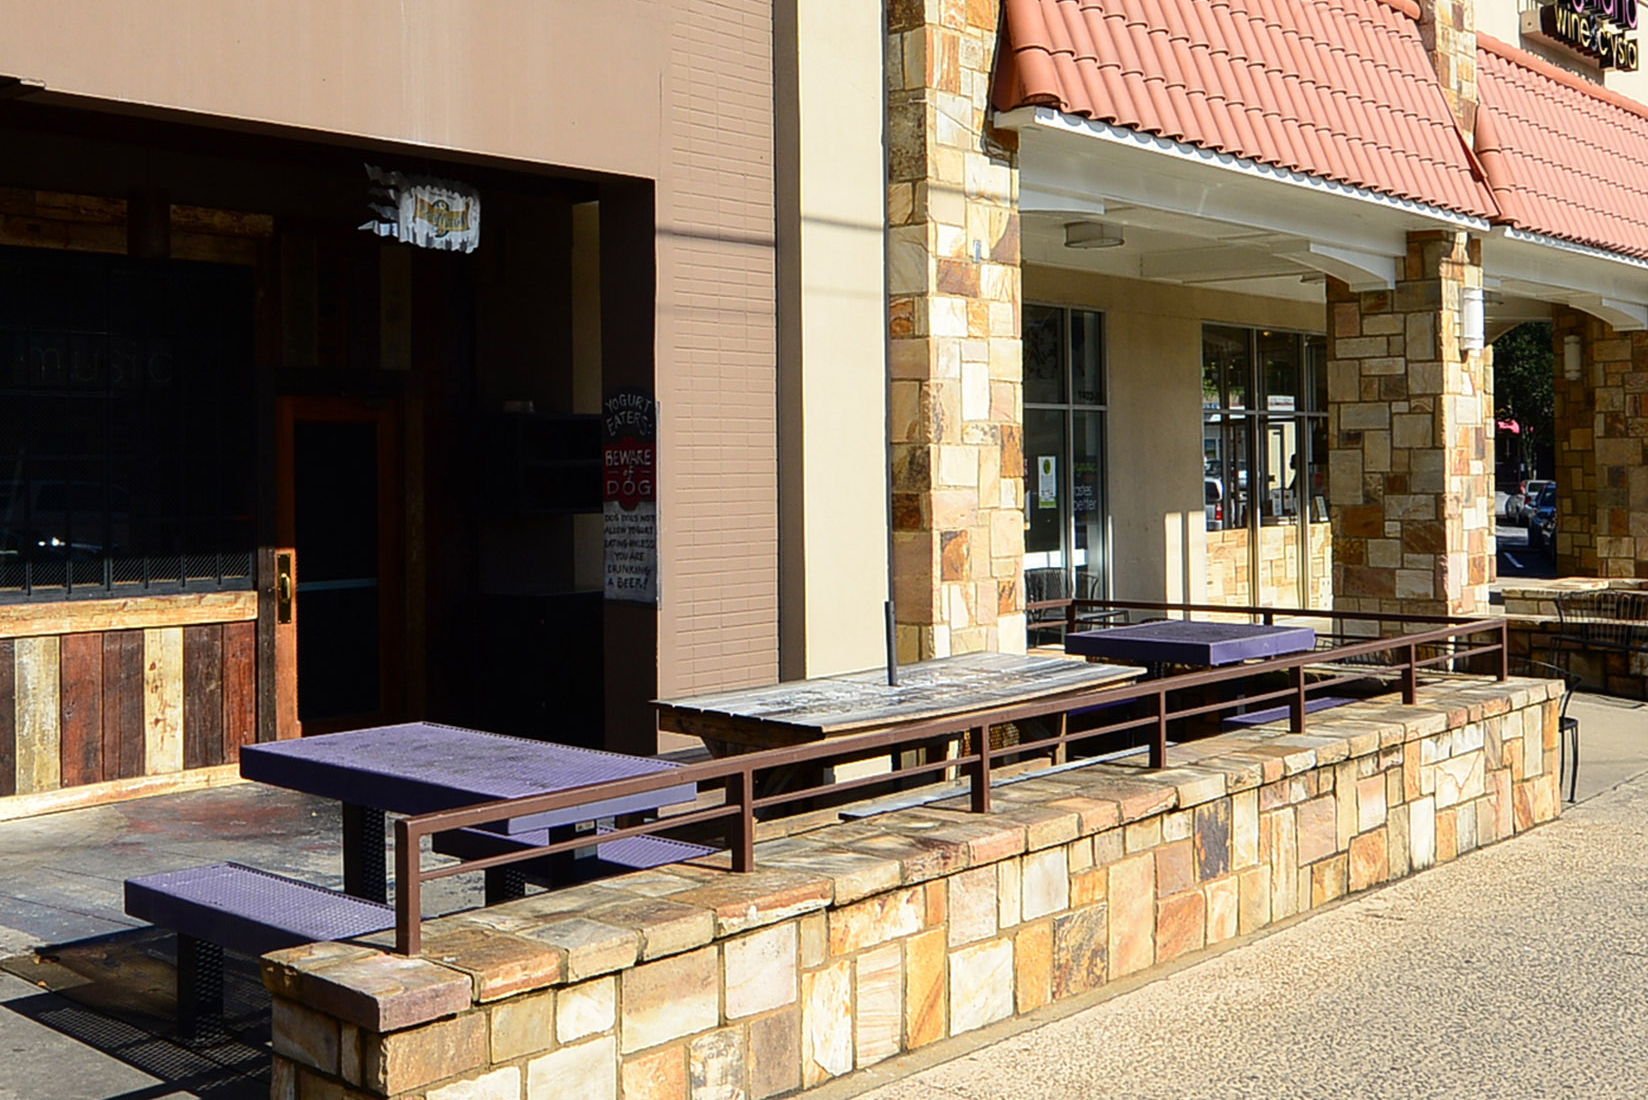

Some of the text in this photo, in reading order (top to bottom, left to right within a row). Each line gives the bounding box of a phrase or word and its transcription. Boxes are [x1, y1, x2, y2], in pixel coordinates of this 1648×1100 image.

[605, 394, 652, 412] YOGURT
[605, 449, 652, 466] BEWARE
[607, 480, 652, 495] DOG
